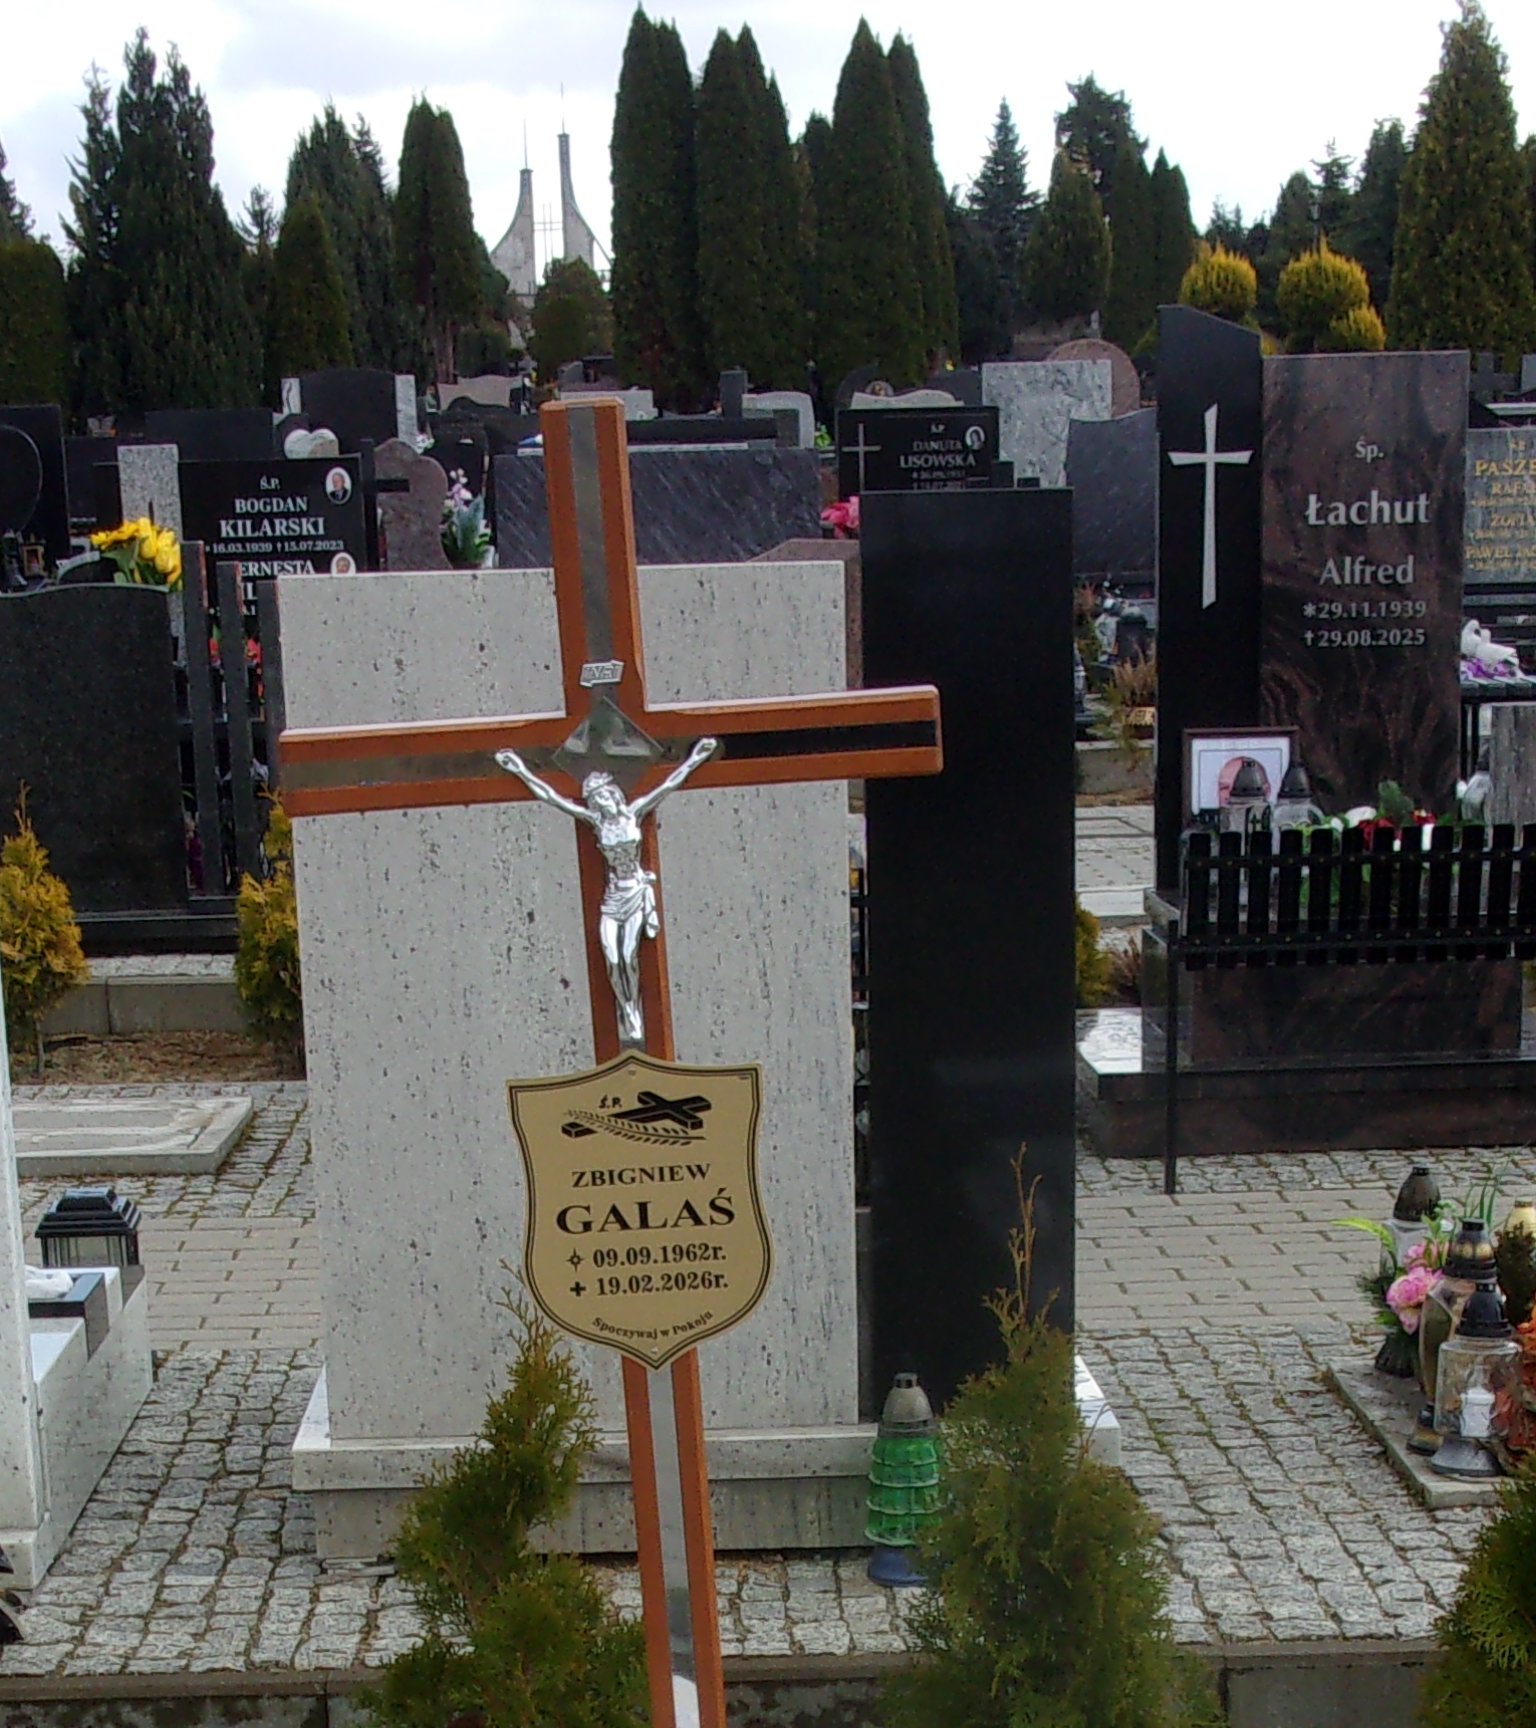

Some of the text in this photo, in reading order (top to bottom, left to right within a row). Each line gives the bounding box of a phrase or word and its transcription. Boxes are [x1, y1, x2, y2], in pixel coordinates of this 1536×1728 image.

[900, 452, 976, 468] LISOWSKA
[234, 497, 307, 514] BOGDAN
[1305, 490, 1431, 526] Łachut
[220, 517, 325, 538] KILARSKI
[1320, 555, 1414, 586] Alfred
[1318, 601, 1427, 619] 29.11.1939
[1318, 628, 1425, 647] 29.08.2025
[599, 1094, 623, 1109] Ś.P.
[571, 1163, 711, 1188] ZBIGNIEW
[556, 1187, 735, 1235] GALAŚ
[593, 1243, 727, 1268] 09.09.1962r.
[597, 1271, 729, 1296] 19.02.2026r.
[592, 1317, 658, 1340] Spoczywaj
[672, 1311, 713, 1336] Pokoju
